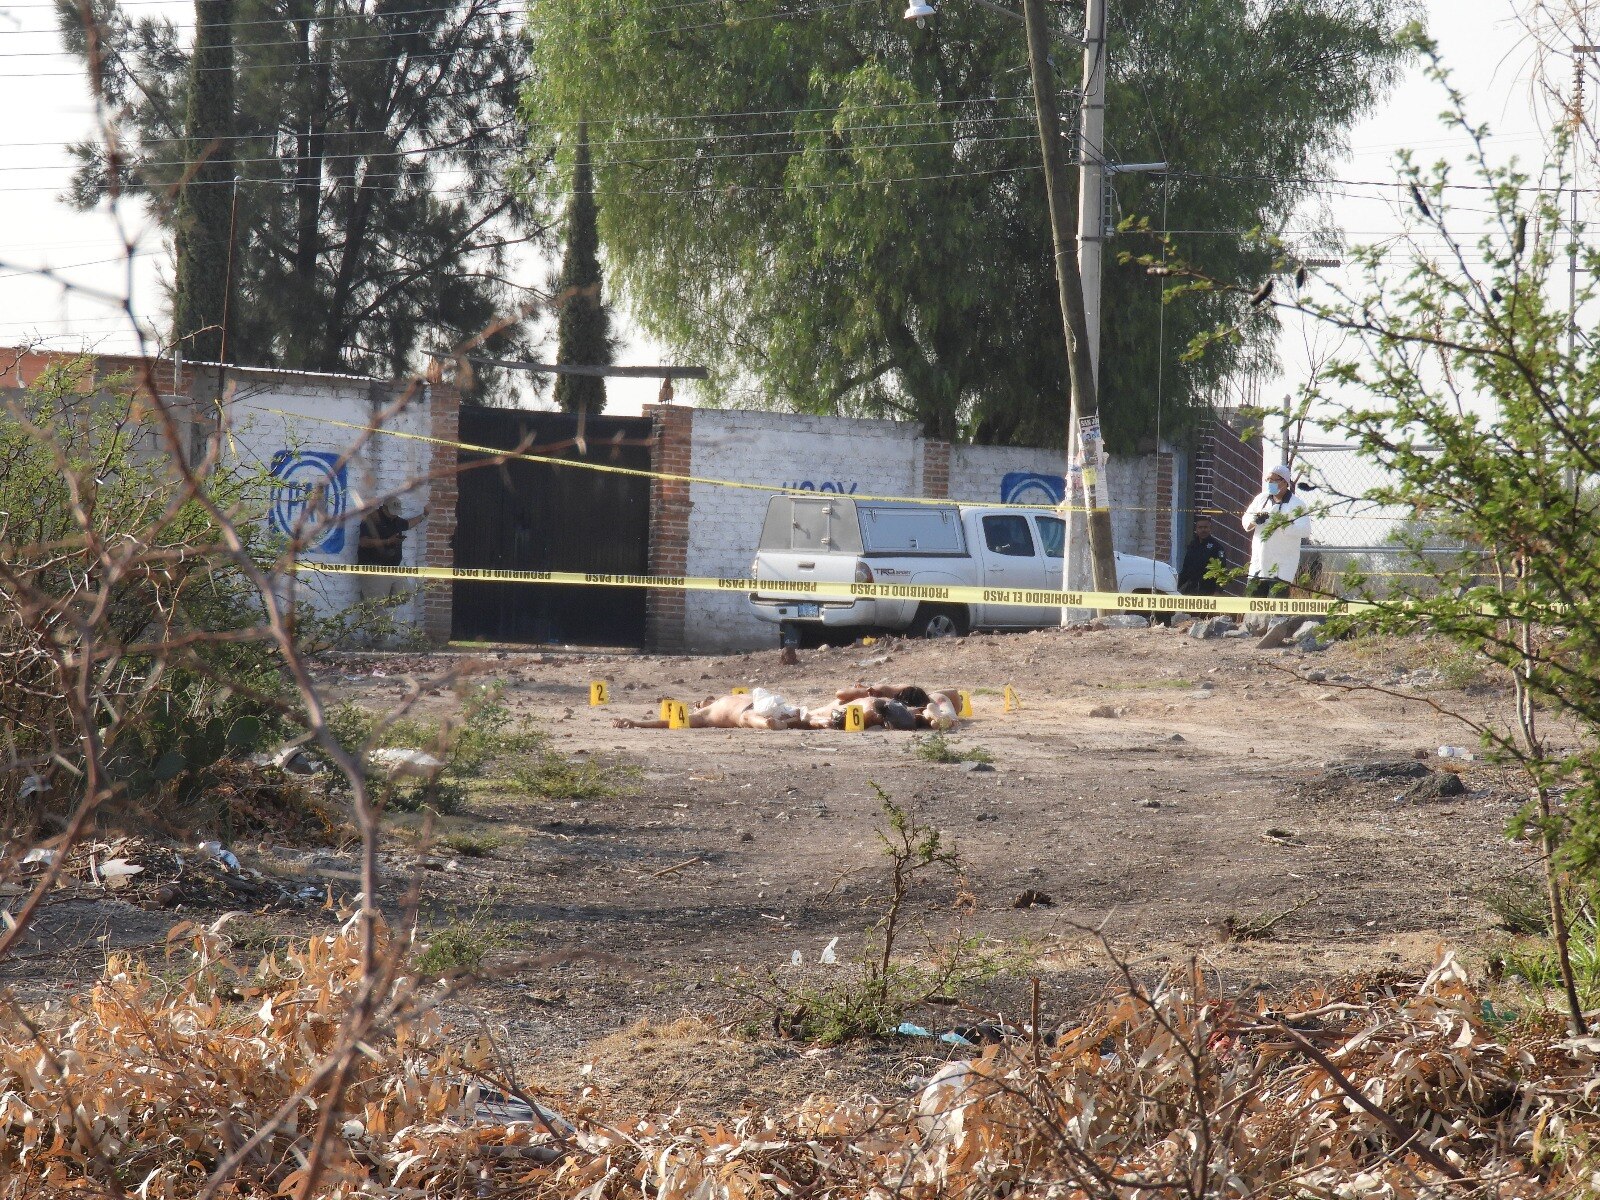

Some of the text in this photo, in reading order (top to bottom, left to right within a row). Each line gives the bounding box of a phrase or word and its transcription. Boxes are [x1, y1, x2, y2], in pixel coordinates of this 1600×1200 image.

[850, 583, 949, 599] PROHIBIDO EL PASO
[983, 590, 1083, 605] PROHIBIDO EL PASO
[1117, 596, 1217, 610] PROHIBIDO EL PASO
[1249, 600, 1276, 612] PASO
[1279, 601, 1289, 612] EL
[596, 684, 605, 701] 2
[678, 705, 685, 724] 4
[852, 707, 860, 726] 6
